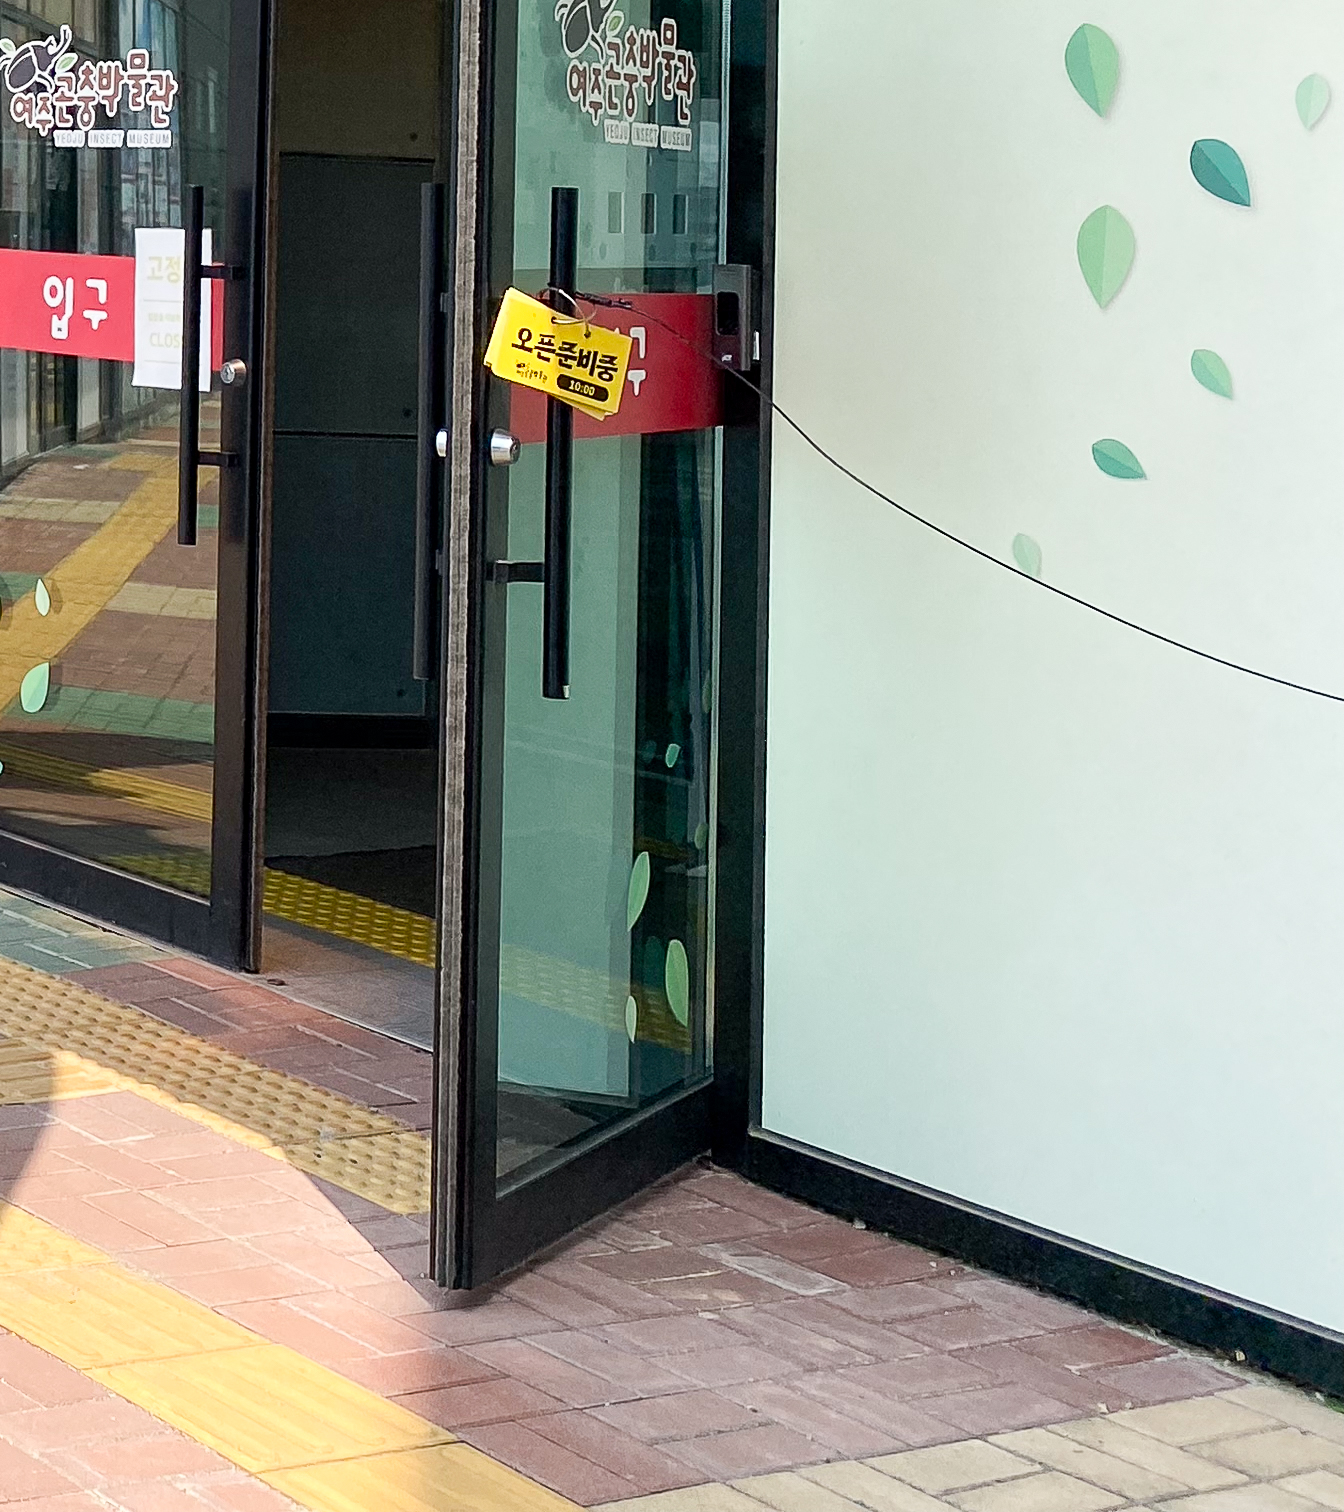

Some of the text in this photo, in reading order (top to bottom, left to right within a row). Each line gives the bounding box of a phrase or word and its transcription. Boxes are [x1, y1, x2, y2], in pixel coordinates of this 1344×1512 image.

[569, 21, 694, 123] 여주곤충박물관
[13, 51, 176, 135] 여주곤충박물관
[56, 133, 169, 145] YEOJU INSECT MUSEUM
[606, 125, 691, 147] YEOJU INSECT MUSEUM
[147, 255, 182, 284] 고정
[43, 275, 108, 339] 입구
[150, 332, 181, 348] CLOS
[512, 327, 618, 383] 오픈준비중
[569, 380, 596, 396] 10:00
